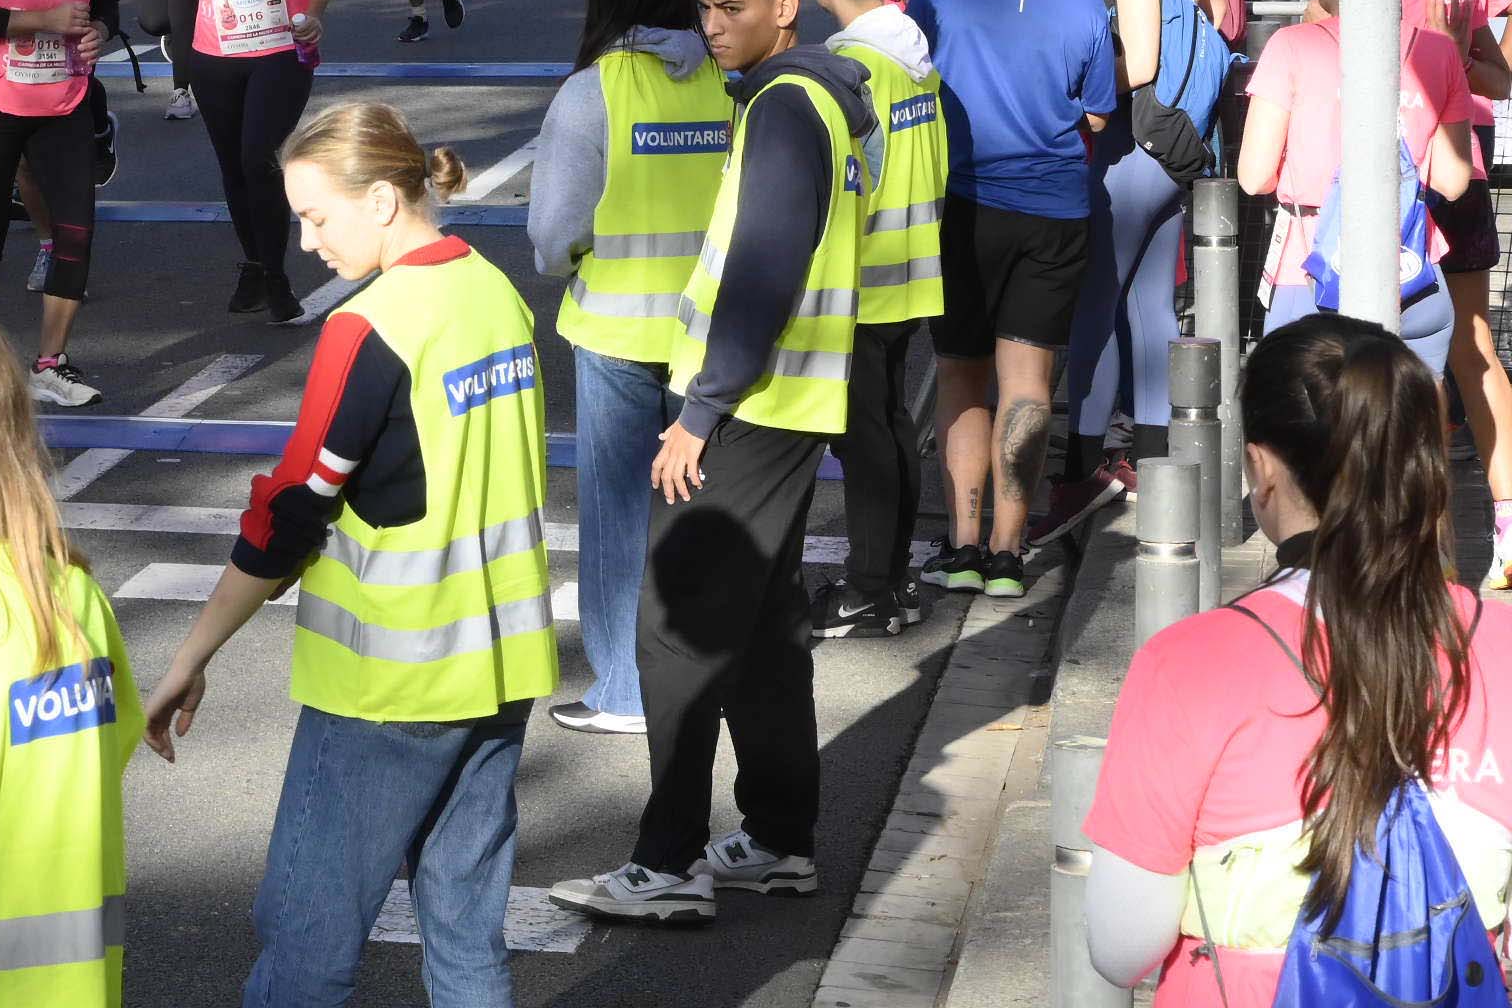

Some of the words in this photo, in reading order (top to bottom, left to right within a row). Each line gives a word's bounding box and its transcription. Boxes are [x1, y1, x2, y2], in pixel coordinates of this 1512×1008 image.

[239, 11, 264, 23] 016
[38, 39, 60, 50] 016
[634, 130, 727, 147] VOLUNTARIS
